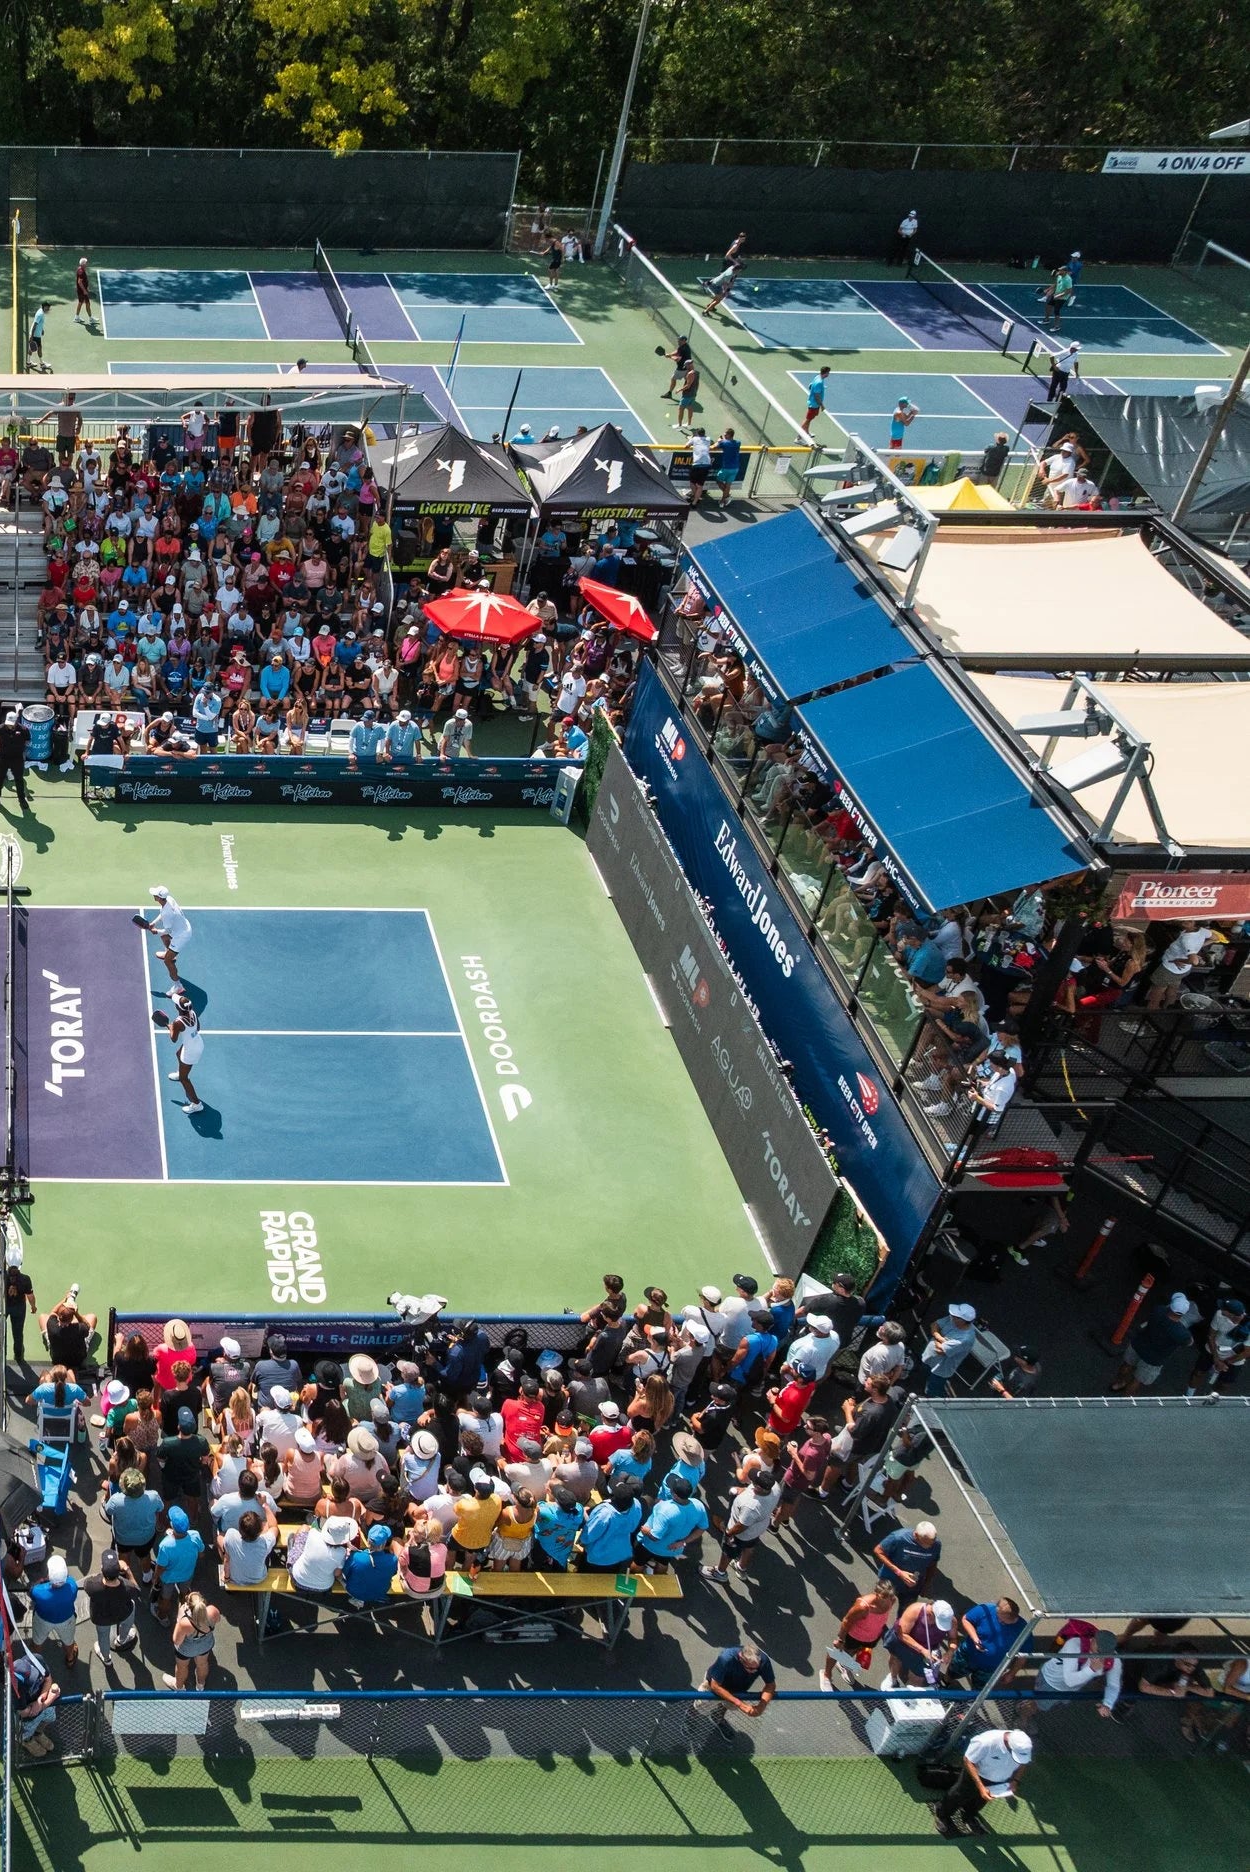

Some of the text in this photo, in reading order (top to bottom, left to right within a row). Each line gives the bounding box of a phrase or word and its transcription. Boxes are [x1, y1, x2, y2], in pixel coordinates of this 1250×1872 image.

[1158, 156, 1246, 170] 4 ON/4 OFF
[734, 639, 749, 658] OPEN
[797, 729, 811, 750] AHC
[133, 782, 172, 801] Kitchen
[213, 782, 252, 801] Kitchen
[293, 784, 332, 802] Kitchen
[373, 785, 413, 804] Kitchen
[453, 785, 494, 804] Kitchen
[597, 805, 620, 853] DOORDASH
[839, 788, 852, 813] BEER
[861, 823, 878, 849] OPEN
[882, 855, 899, 880] AHC
[1135, 881, 1223, 898] Pioneer
[460, 955, 520, 1075] DOORDASH
[676, 982, 701, 1035] DOORDASH
[756, 1044, 793, 1119] DALLAS FLASH
[837, 1074, 853, 1103] BEER
[861, 1120, 878, 1150] OPEN
[259, 1210, 299, 1304] RAPIDS
[287, 1210, 327, 1304] GRAND
[350, 1334, 405, 1345] CHALLEN
